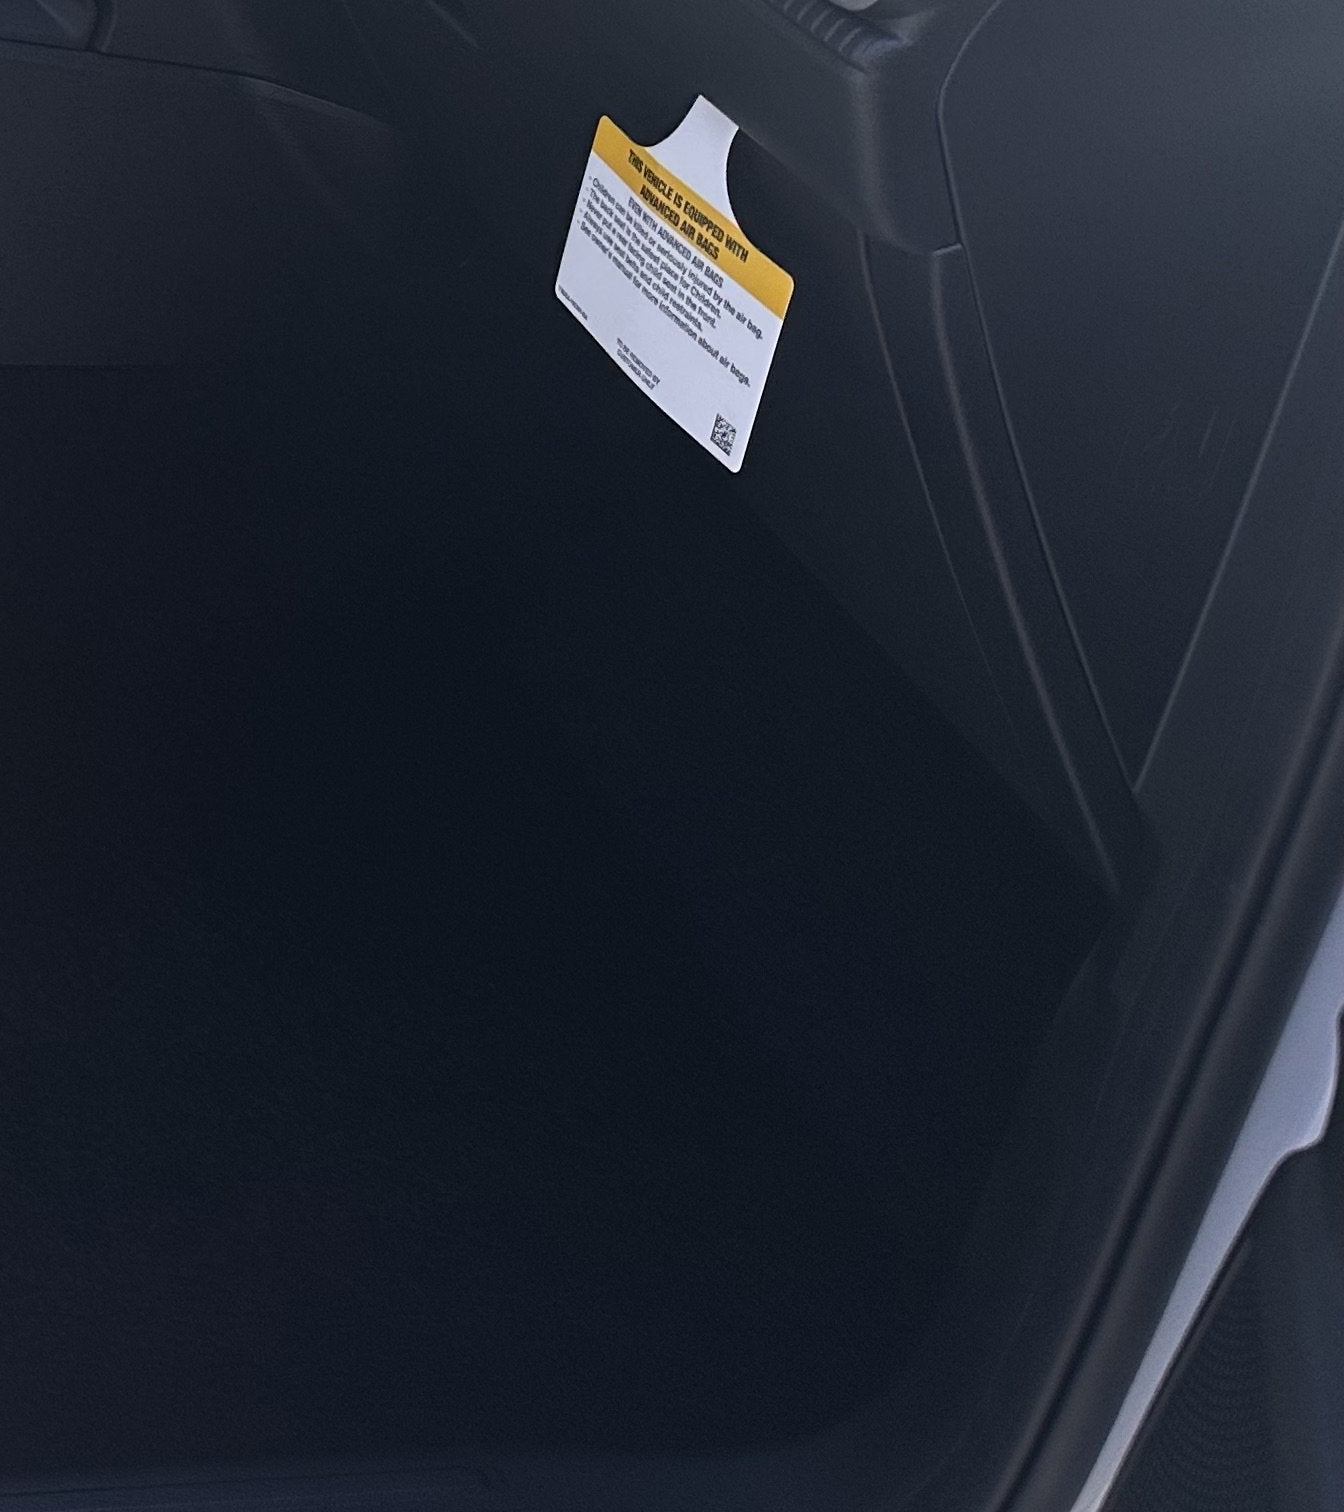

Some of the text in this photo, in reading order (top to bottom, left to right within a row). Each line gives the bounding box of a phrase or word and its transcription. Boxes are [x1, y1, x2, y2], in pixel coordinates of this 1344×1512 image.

[628, 149, 748, 262] THIS VEHICLE IS EQUIPPED WITH
[640, 184, 719, 259] ADVANCED AIR BAGS
[628, 196, 642, 217] EVEN
[657, 226, 691, 260] ADVANCED
[690, 255, 704, 271] AIR
[704, 265, 723, 288] BAGS
[645, 262, 662, 280] child
[677, 288, 684, 300] in
[685, 295, 696, 311] the
[648, 236, 656, 247] or
[656, 243, 687, 275] seriously
[687, 269, 713, 296] injured
[712, 290, 723, 306] by
[723, 299, 735, 315] the
[735, 311, 747, 324] air
[746, 319, 762, 339] bag.
[651, 282, 669, 300] child
[659, 260, 678, 280] place
[679, 275, 690, 290] for
[690, 285, 720, 318] Children.
[658, 300, 697, 340] information
[697, 337, 719, 359] about
[718, 355, 730, 368] air
